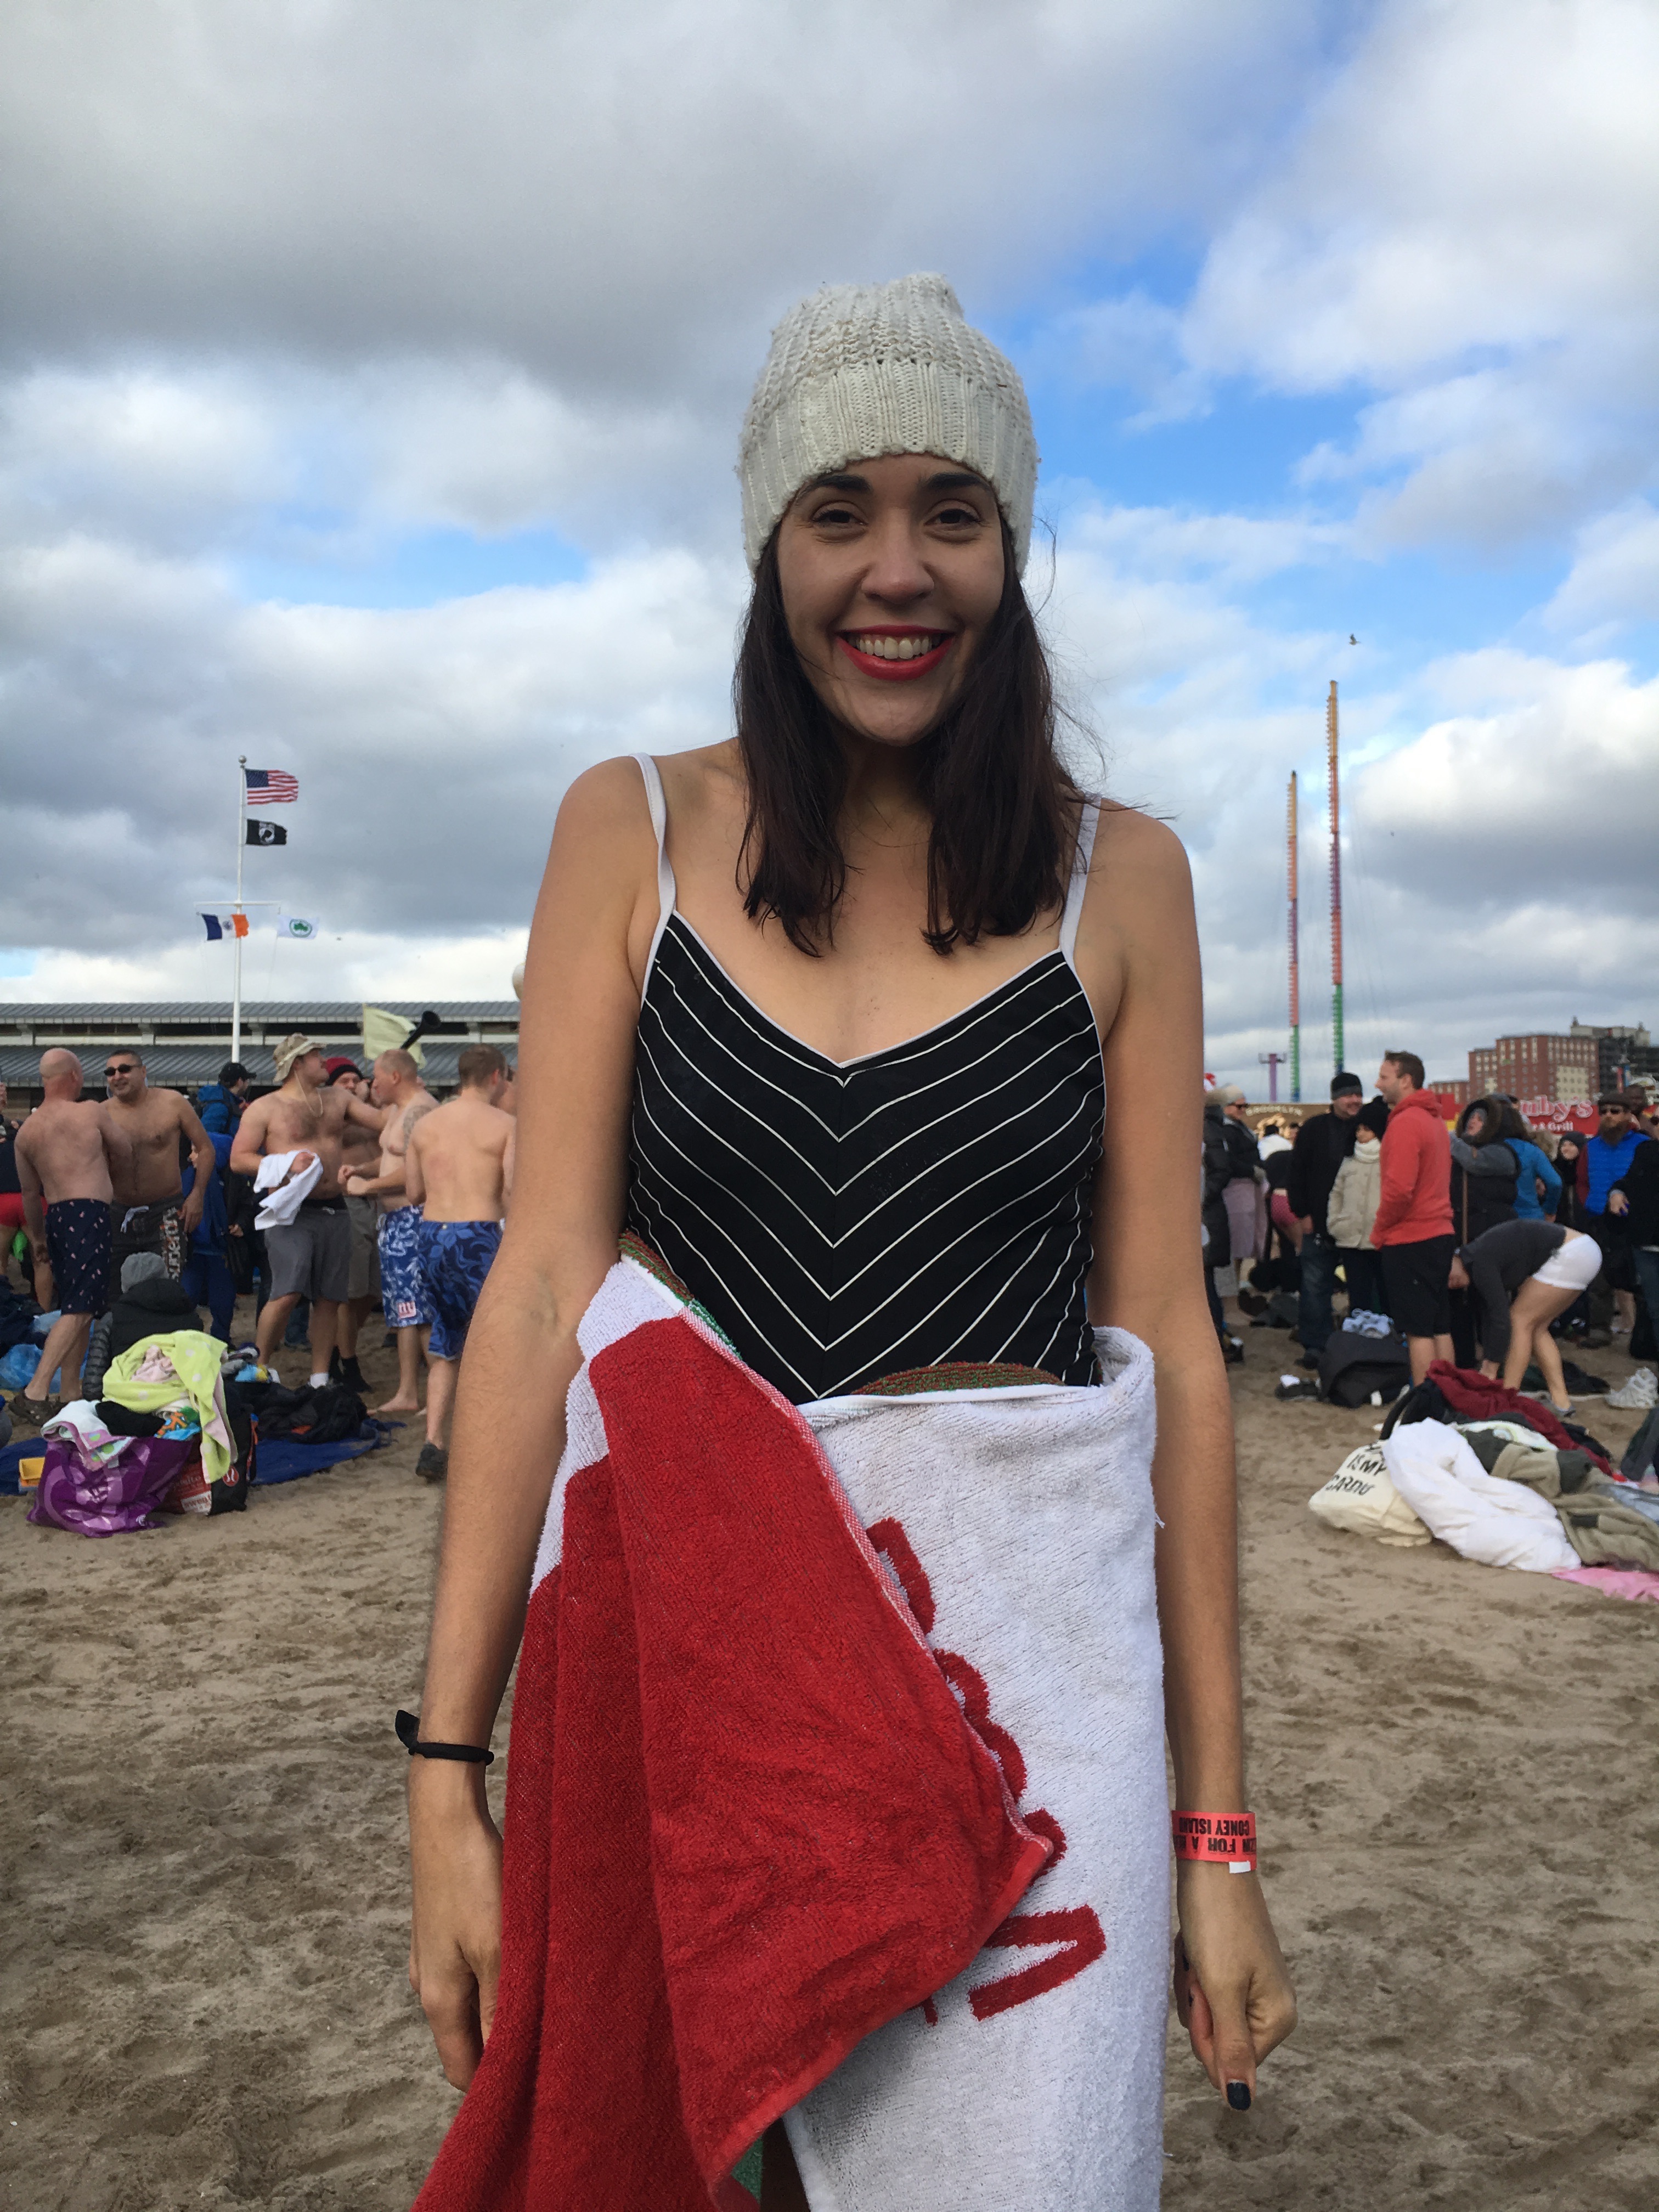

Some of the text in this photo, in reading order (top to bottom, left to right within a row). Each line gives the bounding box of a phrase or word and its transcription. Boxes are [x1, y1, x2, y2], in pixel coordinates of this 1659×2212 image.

[1519, 1094, 1593, 1123] uby's
[1215, 1819, 1250, 1836] CONEY
[1207, 1837, 1236, 1854] FOR
